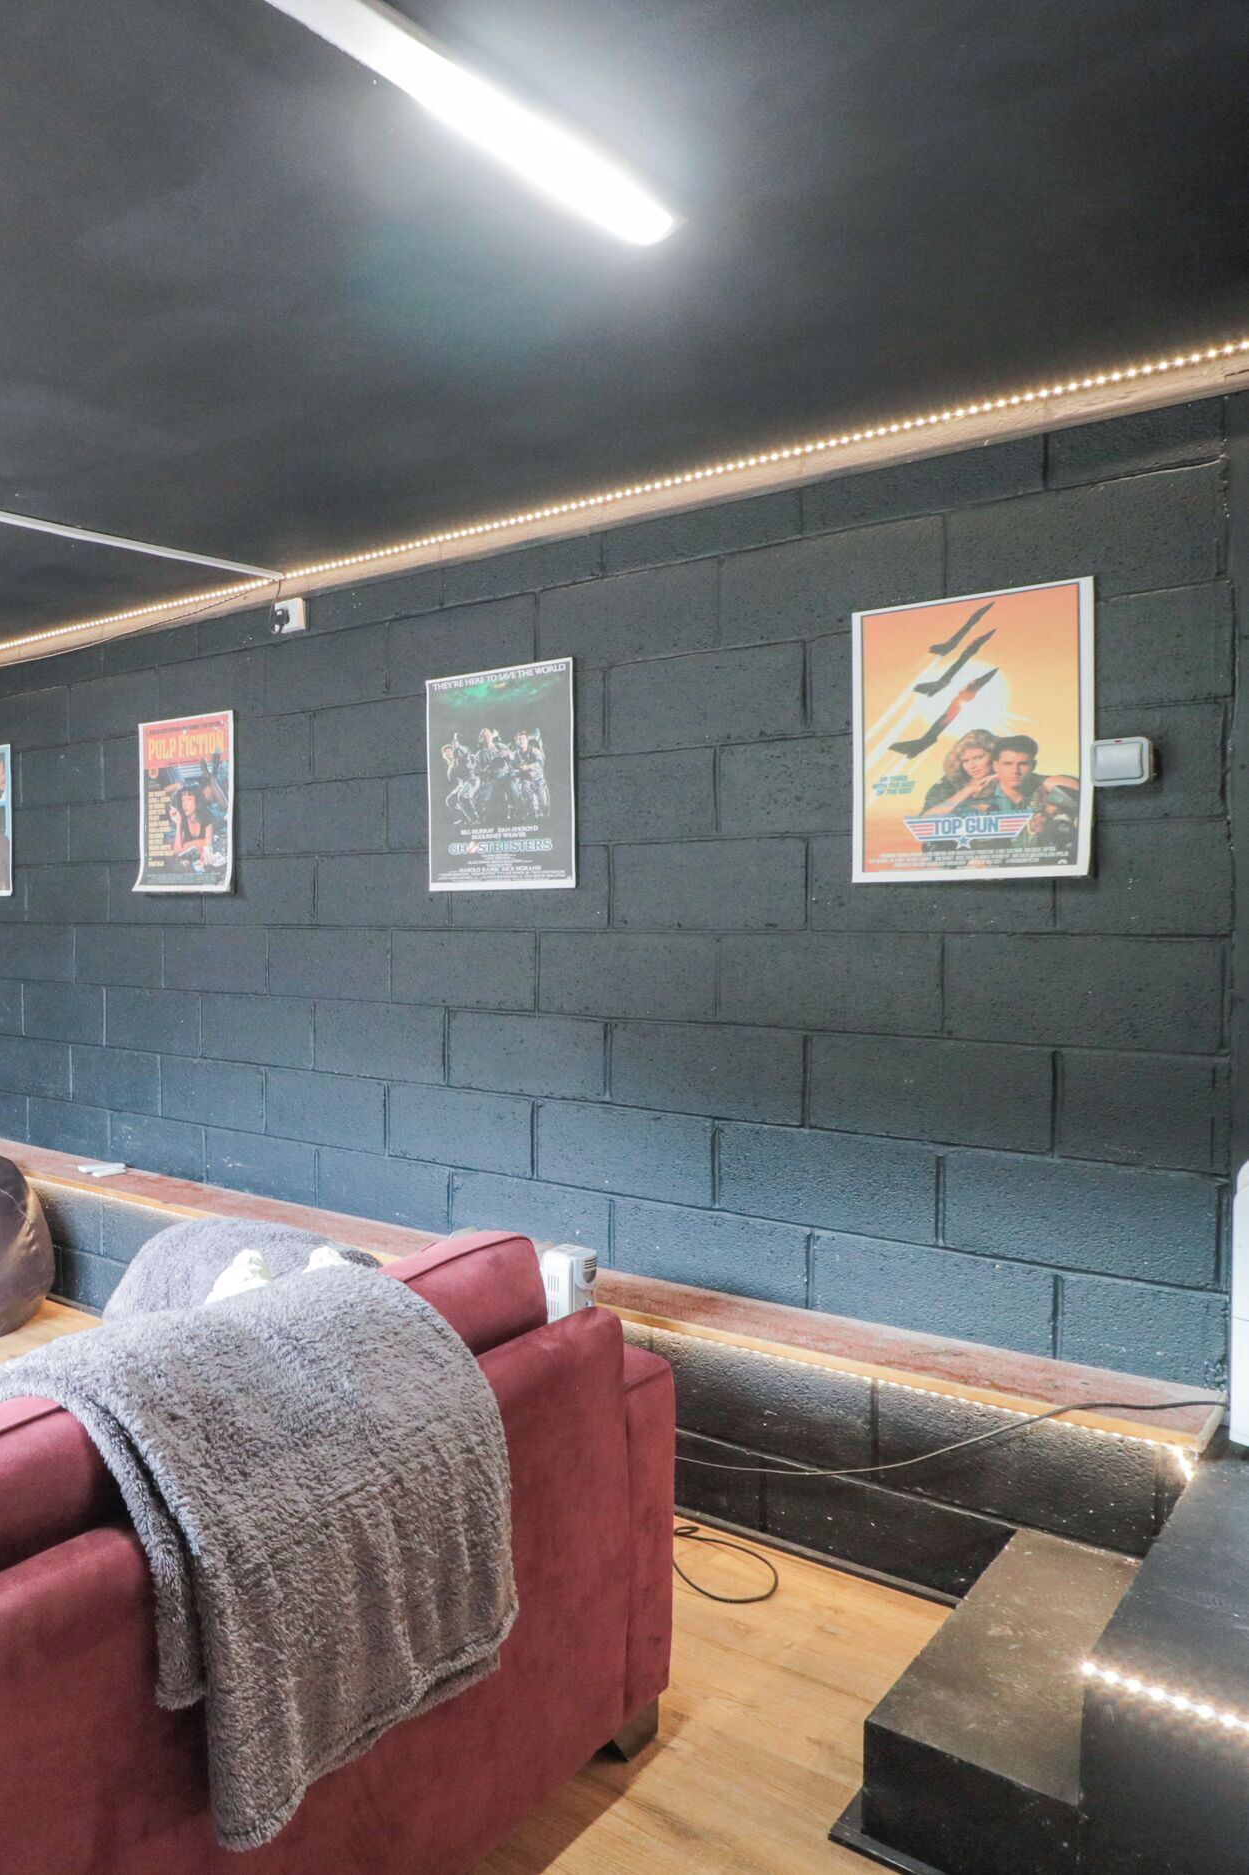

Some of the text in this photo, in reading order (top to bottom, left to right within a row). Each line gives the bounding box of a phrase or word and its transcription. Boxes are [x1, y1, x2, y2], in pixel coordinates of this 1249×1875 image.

[432, 663, 566, 692] THEY'RE HERE TO SAVE THE WORLD
[148, 731, 225, 761] PULP FICTION
[931, 816, 999, 835] TOP GUN
